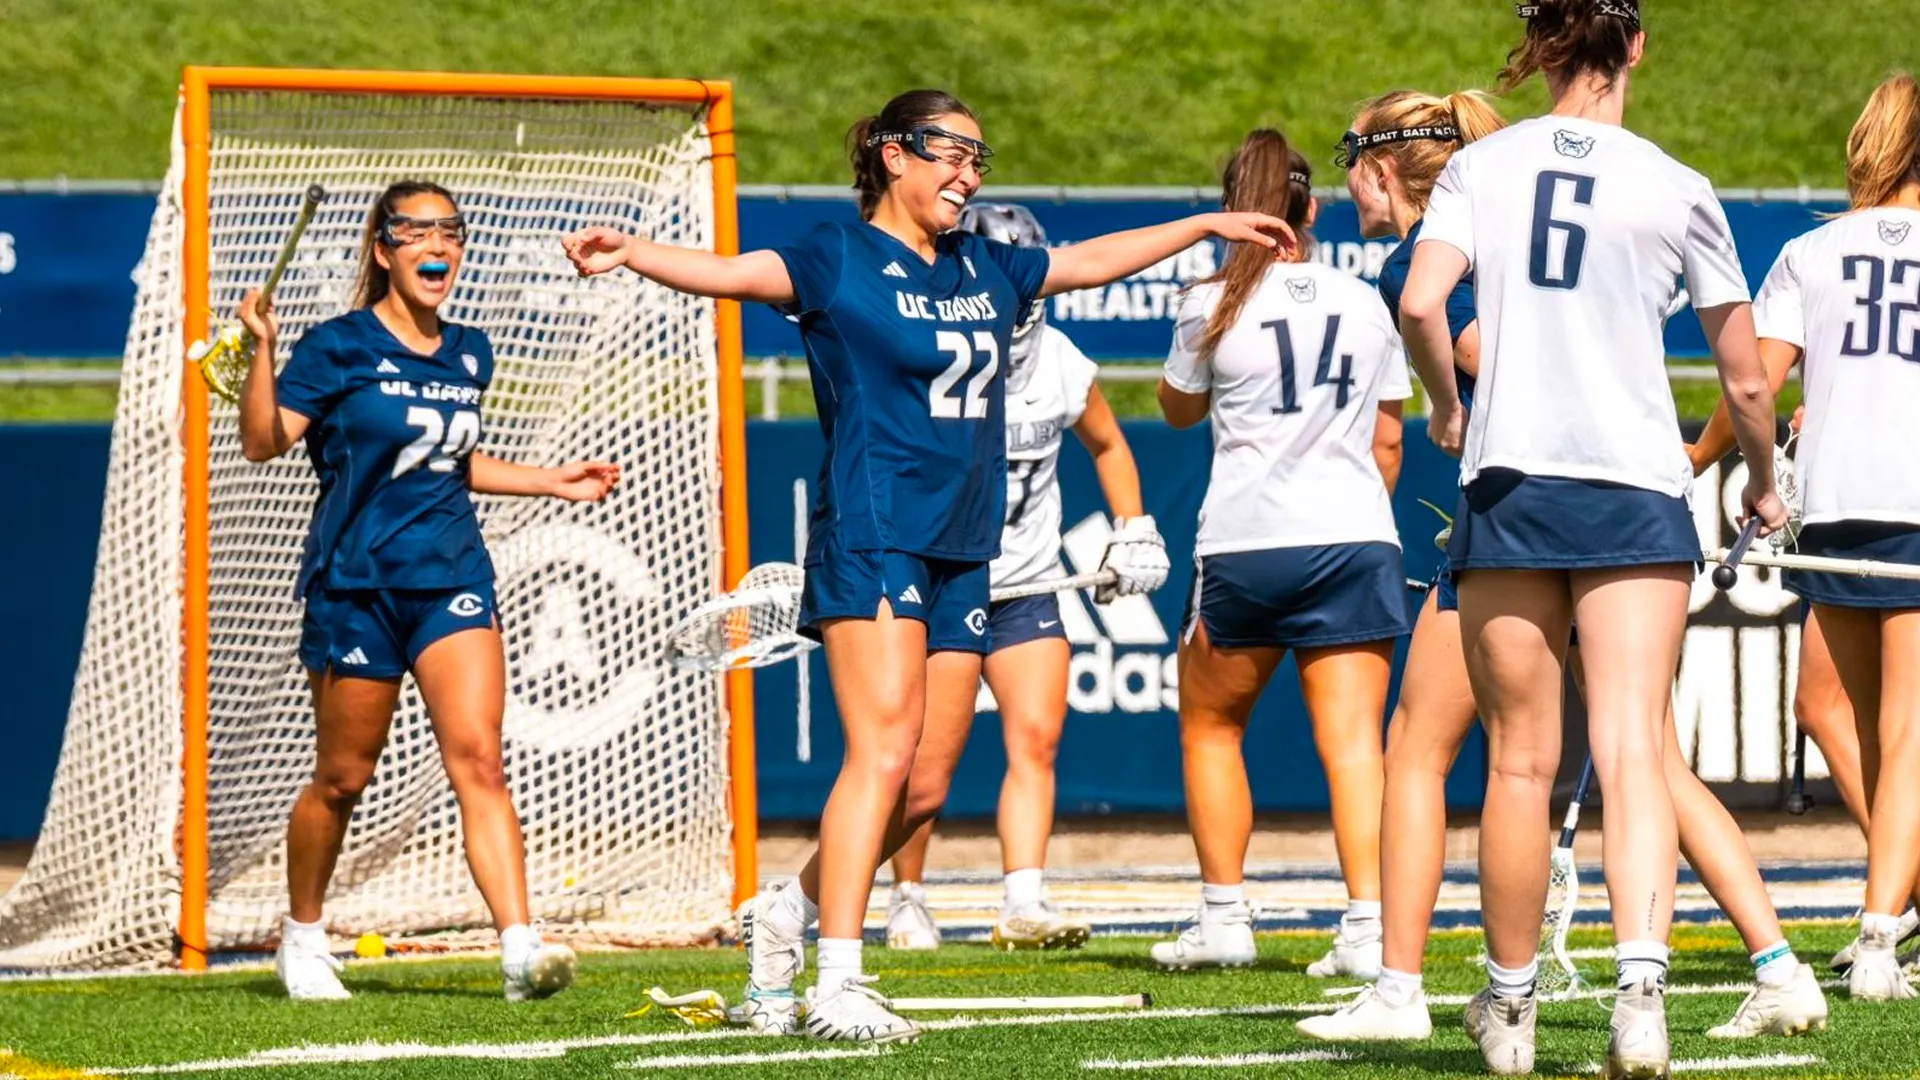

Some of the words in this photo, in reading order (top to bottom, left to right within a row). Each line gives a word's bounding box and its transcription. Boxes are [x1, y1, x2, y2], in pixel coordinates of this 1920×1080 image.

[1372, 131, 1398, 144] GAIT
[1402, 126, 1432, 138] GAIT
[1528, 169, 1598, 291] 6
[896, 290, 937, 320] UC
[935, 291, 998, 322] DAVIS
[928, 330, 999, 419] 22
[1260, 314, 1356, 416] 14
